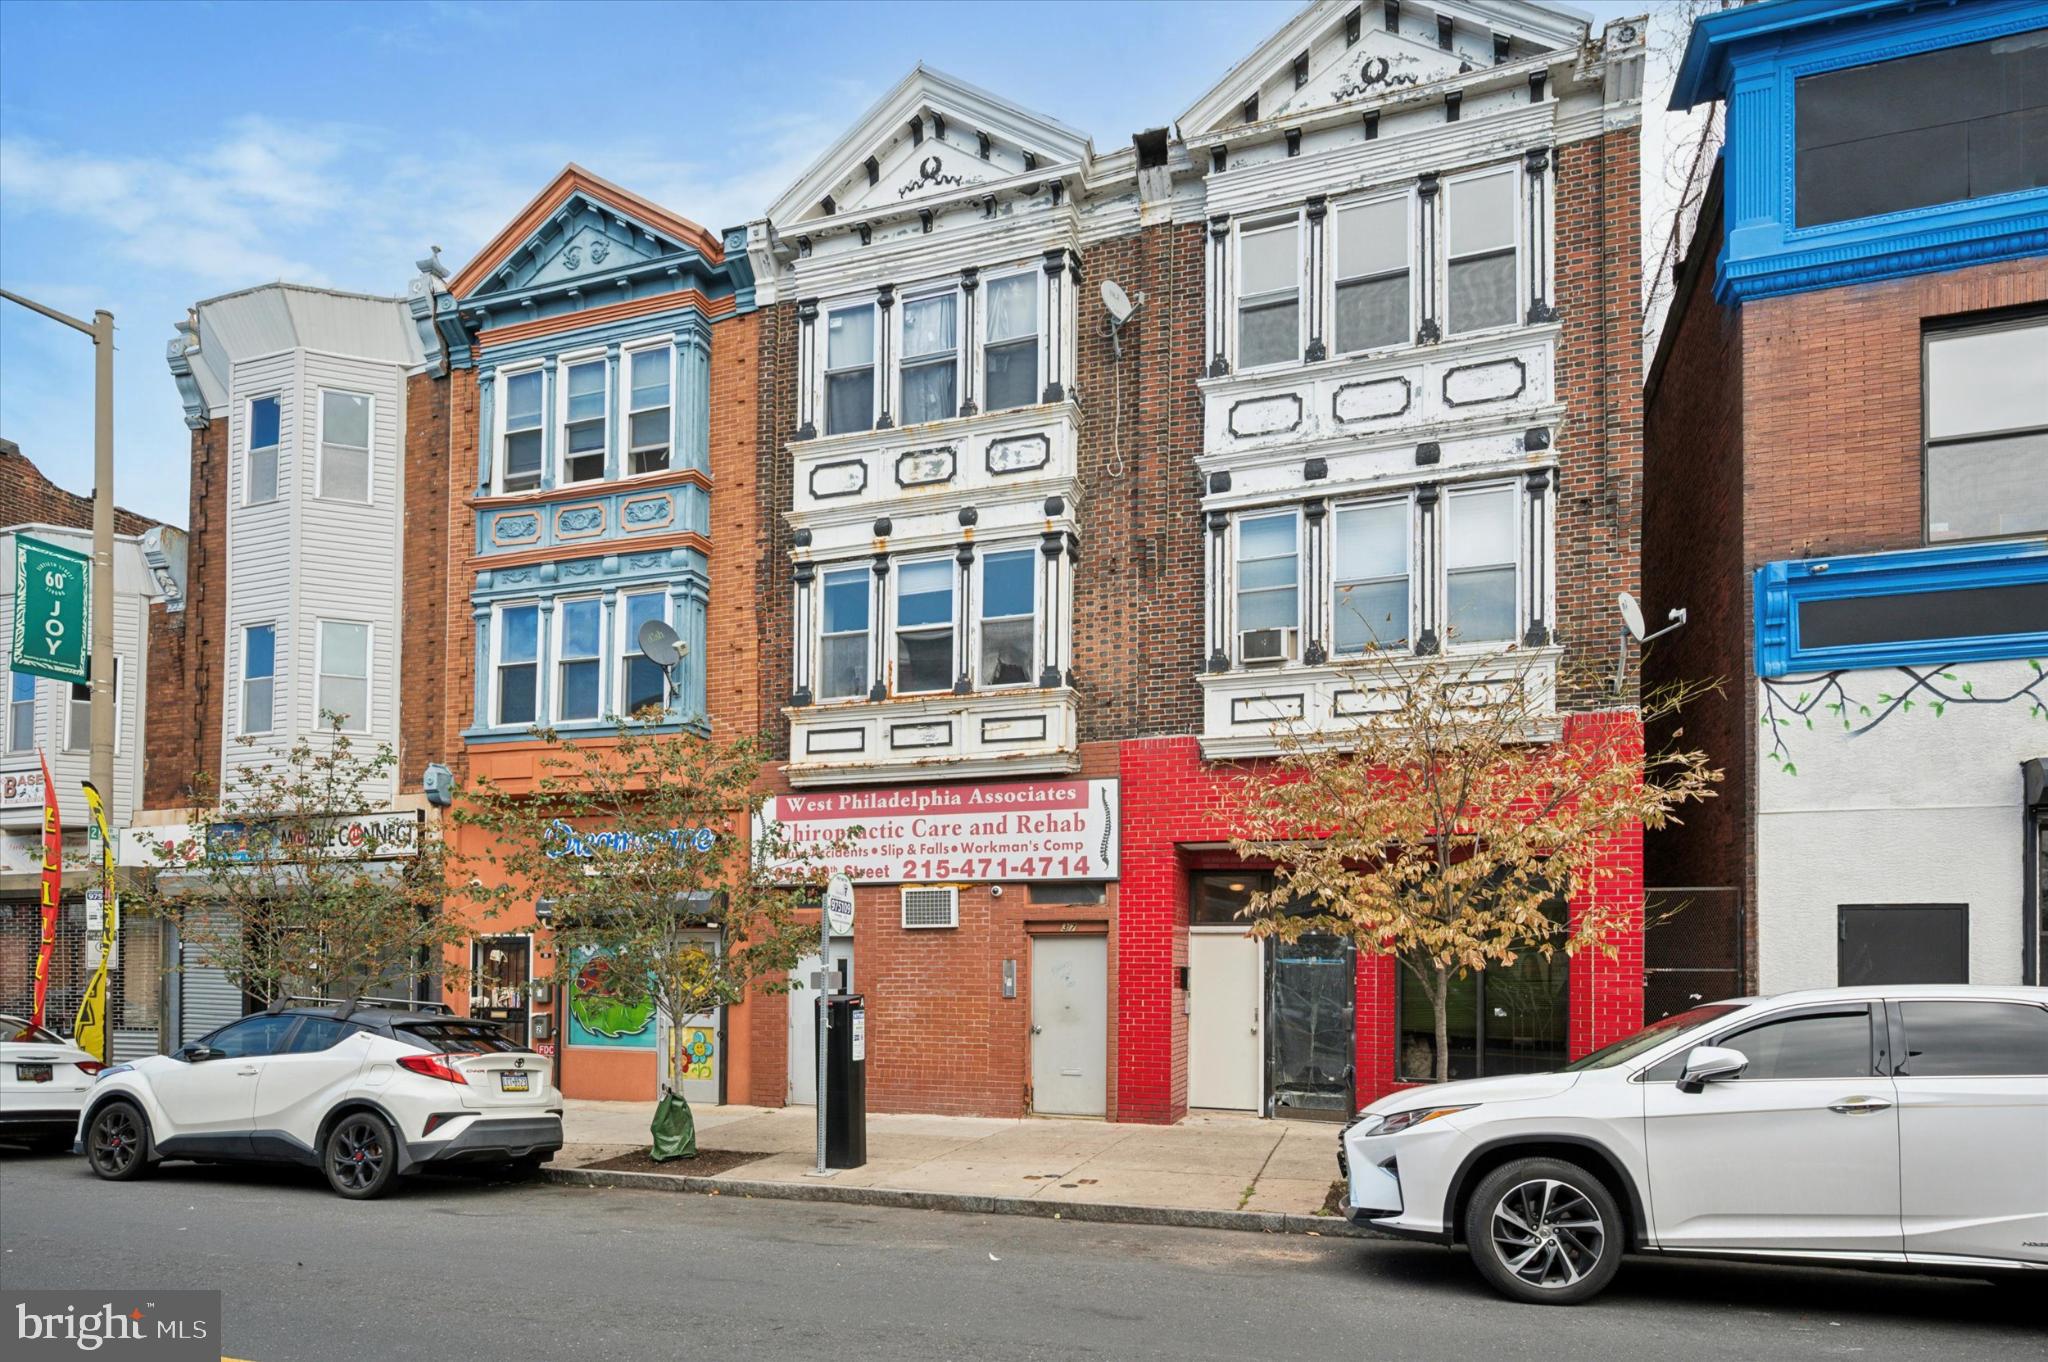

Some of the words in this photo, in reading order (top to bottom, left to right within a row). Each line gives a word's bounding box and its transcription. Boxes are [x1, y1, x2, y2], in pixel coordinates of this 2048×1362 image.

[45, 600, 64, 655] JOY
[787, 797, 833, 812] West
[838, 790, 961, 812] Philadelphia
[968, 786, 1077, 805] Associates
[91, 827, 97, 838] 2
[778, 821, 904, 843] Chiropractic
[911, 818, 962, 838] Care
[970, 814, 1007, 835] and
[1016, 811, 1086, 834] Rehab
[811, 845, 868, 858] Accidents
[880, 845, 905, 859] Slip
[907, 844, 917, 855] &
[920, 843, 949, 855] Falls
[960, 840, 1039, 853] Workman's
[1043, 839, 1084, 854] Comp
[844, 864, 890, 879] Street
[902, 855, 1090, 879] 215-471-4714
[538, 1045, 554, 1054] FDC
